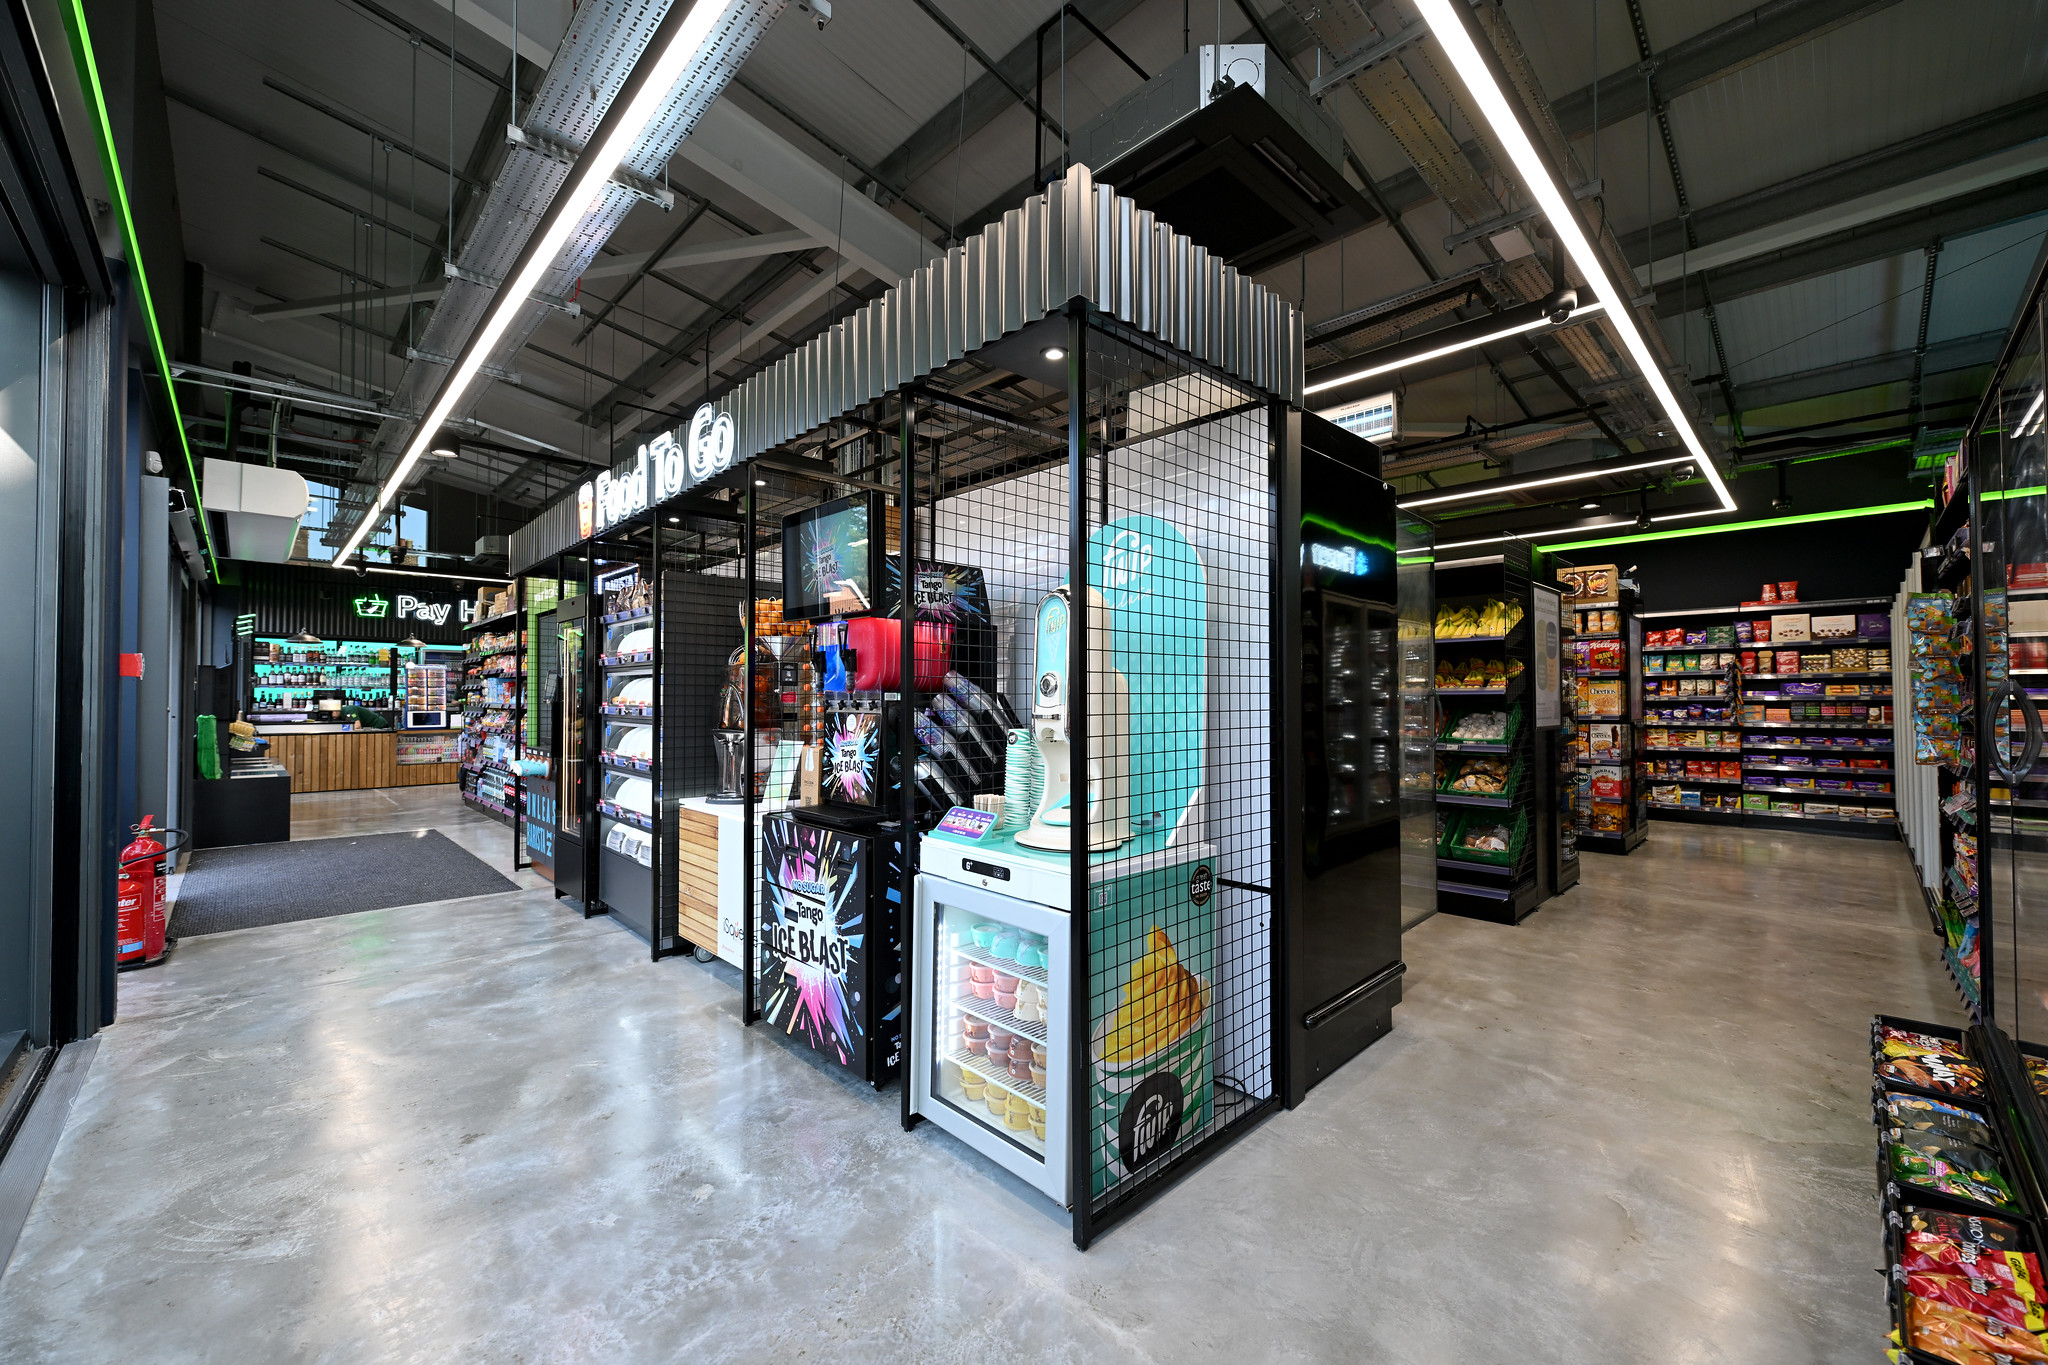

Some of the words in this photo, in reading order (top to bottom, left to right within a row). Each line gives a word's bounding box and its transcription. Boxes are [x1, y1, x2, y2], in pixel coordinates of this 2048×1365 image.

[595, 443, 648, 532] Food
[650, 430, 685, 503] To
[688, 402, 735, 483] Go
[920, 580, 943, 592] Tango
[915, 591, 927, 605] CE
[927, 591, 954, 605] BLAST
[397, 594, 451, 626] Pay
[1594, 651, 1614, 660] KRAVE
[1589, 687, 1616, 695] Cheerios
[841, 749, 857, 759] Tango
[834, 760, 844, 774] ICE
[844, 759, 865, 773] BLAST
[792, 880, 802, 891] NO
[802, 881, 825, 896] SUGAR
[1191, 880, 1210, 894] taste
[796, 901, 824, 927] Tango
[773, 923, 796, 959] ICE
[798, 928, 849, 975] BLAST
[887, 1051, 900, 1068] ICE
